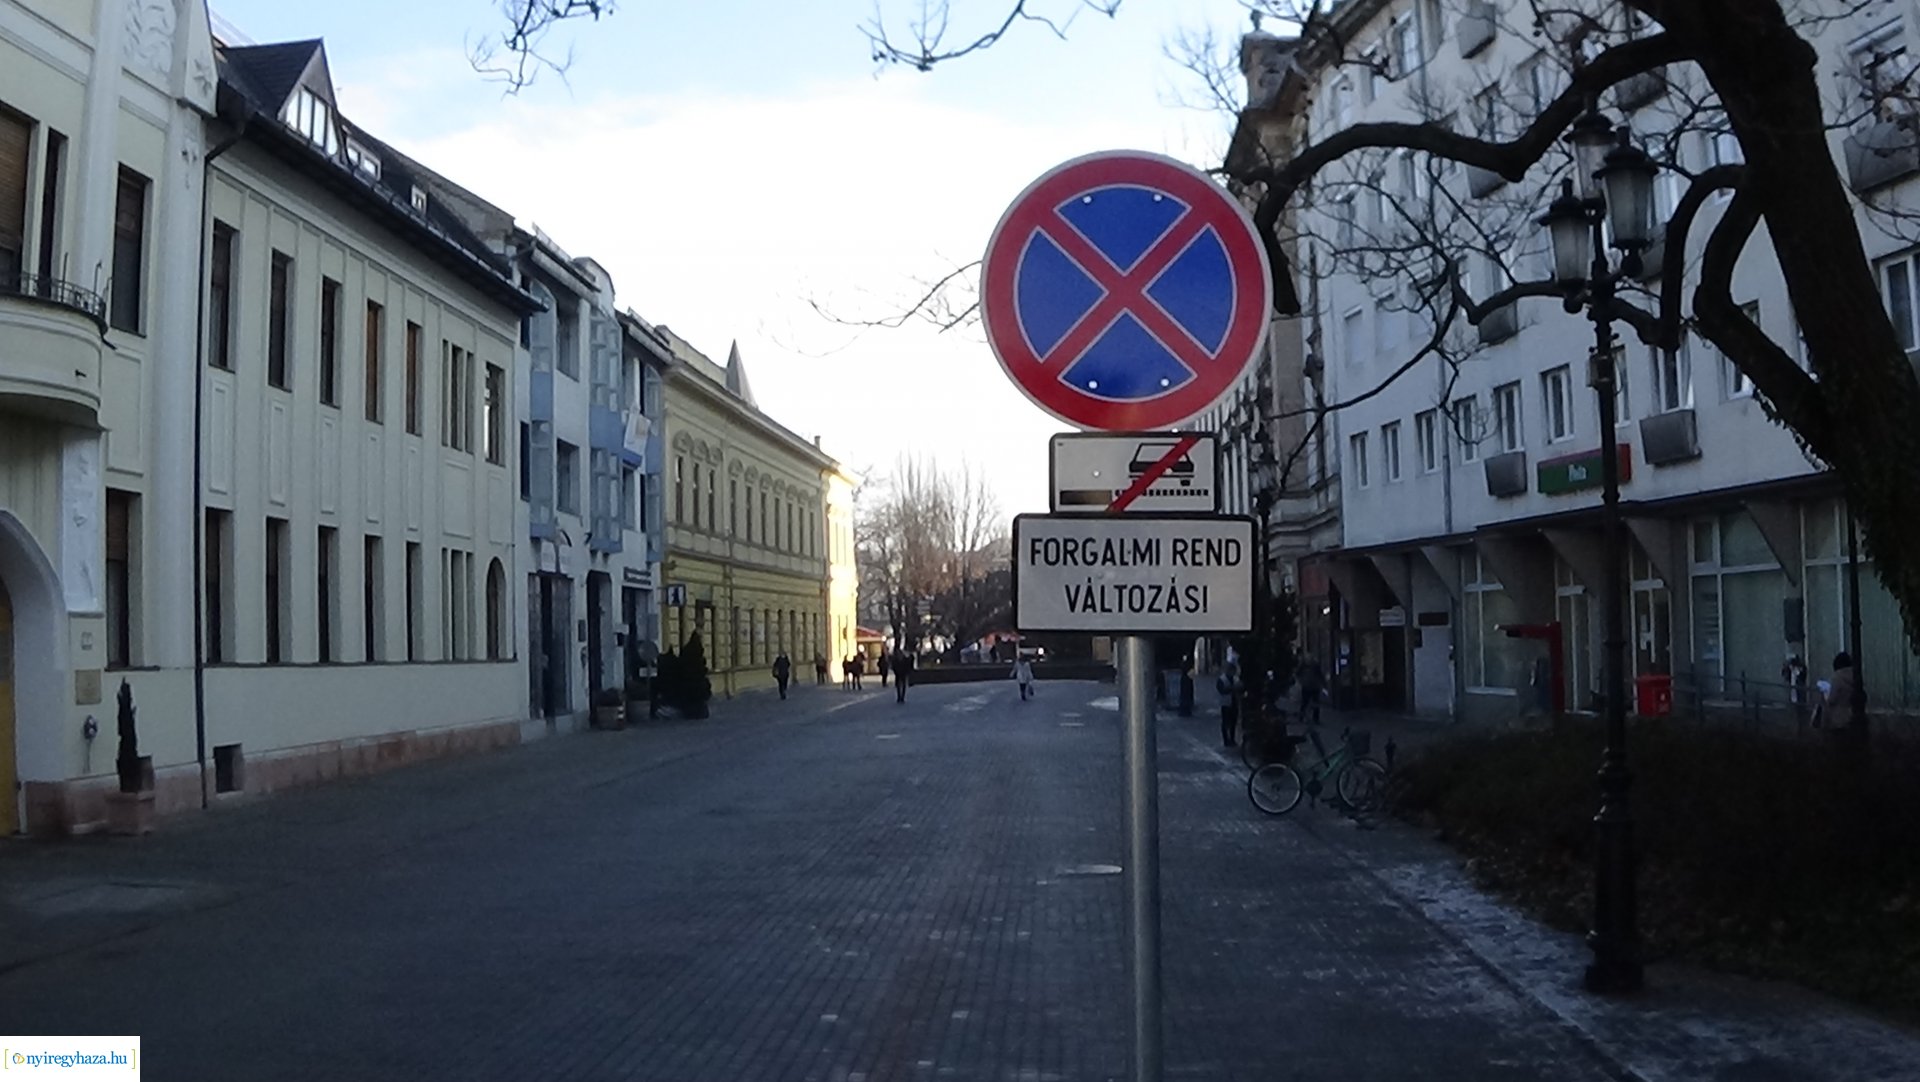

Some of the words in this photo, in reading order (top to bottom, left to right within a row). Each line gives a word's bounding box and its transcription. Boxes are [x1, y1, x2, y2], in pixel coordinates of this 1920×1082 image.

[1030, 537, 1160, 567] FORGALMI
[1172, 537, 1242, 567] REND
[1065, 575, 1208, 613] VÁLTOZÁS!
